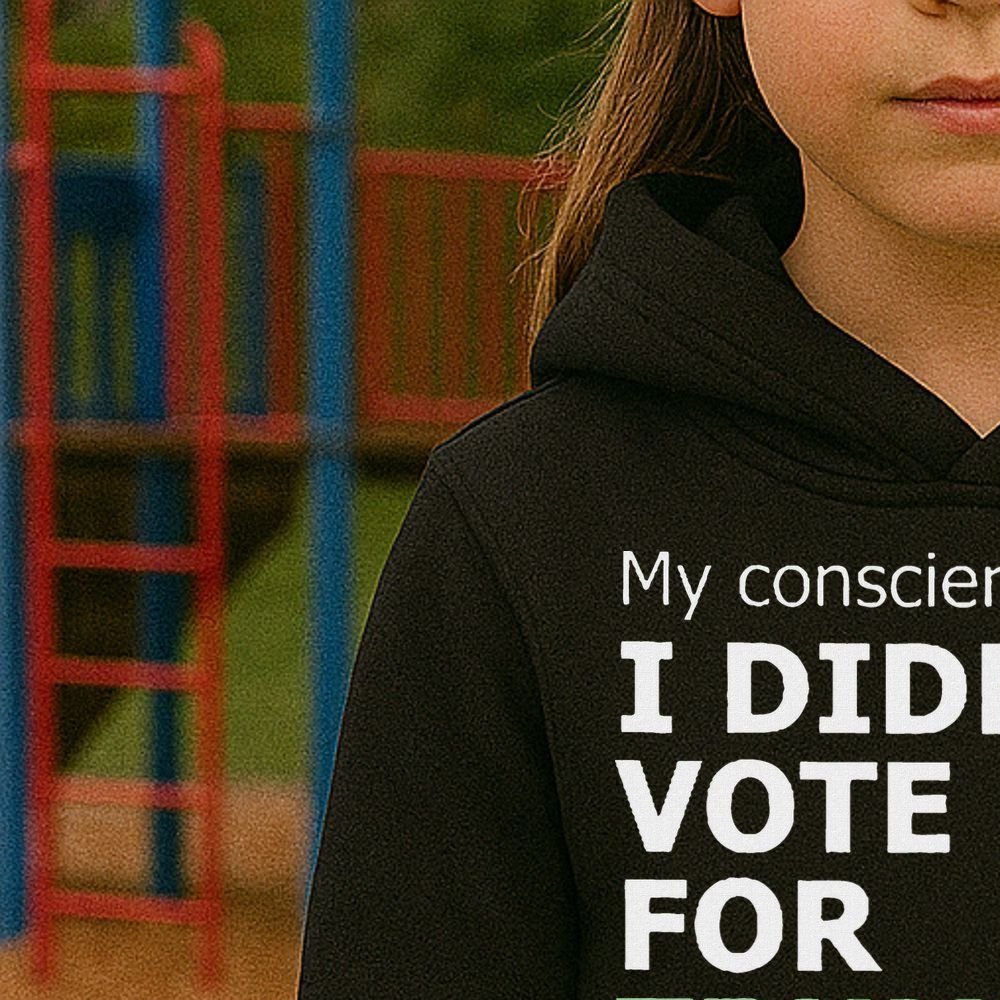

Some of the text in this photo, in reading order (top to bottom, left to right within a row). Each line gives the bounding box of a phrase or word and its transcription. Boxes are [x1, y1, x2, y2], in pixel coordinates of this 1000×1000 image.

[622, 550, 712, 621] My
[620, 640, 674, 735] I
[615, 758, 951, 854] VOTE
[623, 876, 883, 974] FOR
